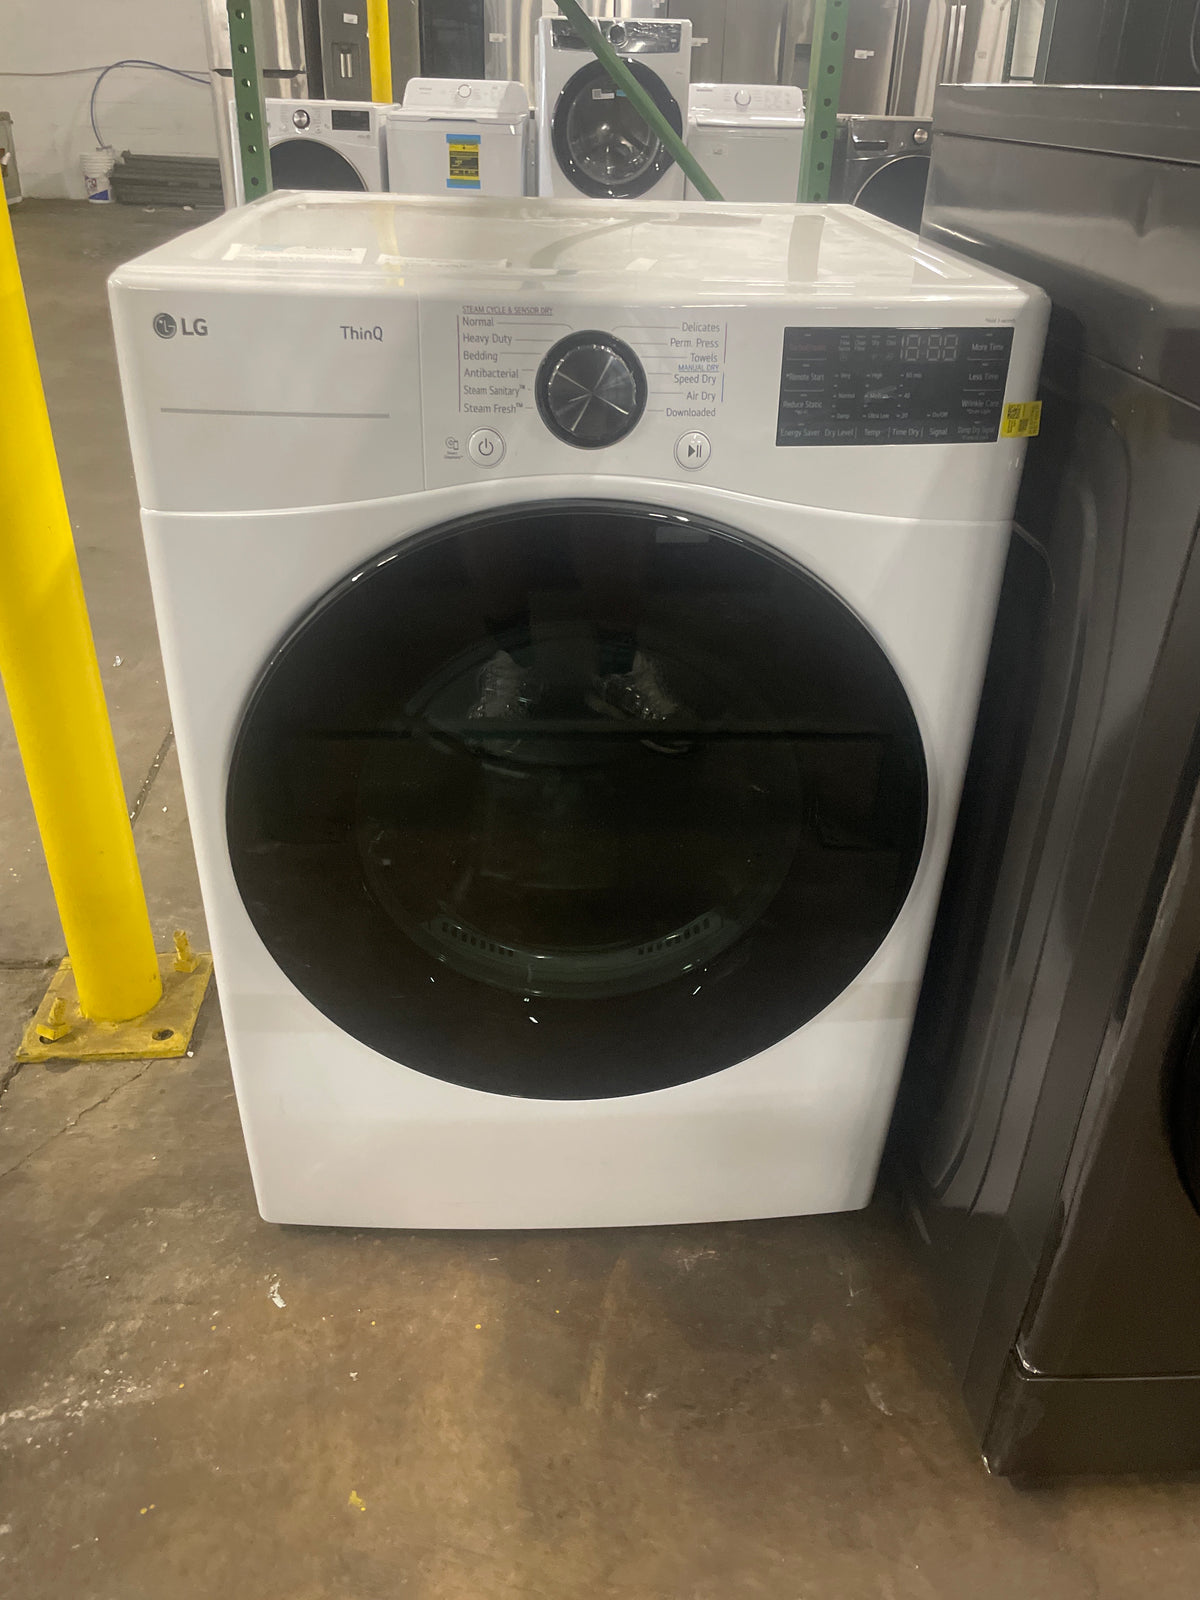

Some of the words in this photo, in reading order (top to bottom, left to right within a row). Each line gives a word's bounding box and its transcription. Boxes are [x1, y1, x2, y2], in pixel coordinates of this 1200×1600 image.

[181, 318, 208, 336] LG
[462, 316, 494, 327] Normal
[681, 322, 720, 333] Delicates
[340, 326, 383, 342] ThinQ
[462, 332, 489, 345] Heavy
[492, 333, 513, 345] Duty
[696, 338, 719, 348] Press
[463, 350, 498, 362] Bedding
[690, 352, 718, 363] Towels
[464, 368, 519, 379] Antibacterial
[674, 374, 699, 385] Speed
[702, 374, 716, 386] Dry
[464, 385, 487, 396] Steam
[686, 391, 699, 400] Air
[701, 391, 716, 402] Dry
[464, 403, 491, 414] Steam
[666, 408, 716, 417] Downloaded
[825, 429, 836, 438] Dry
[908, 428, 919, 438] Dry
